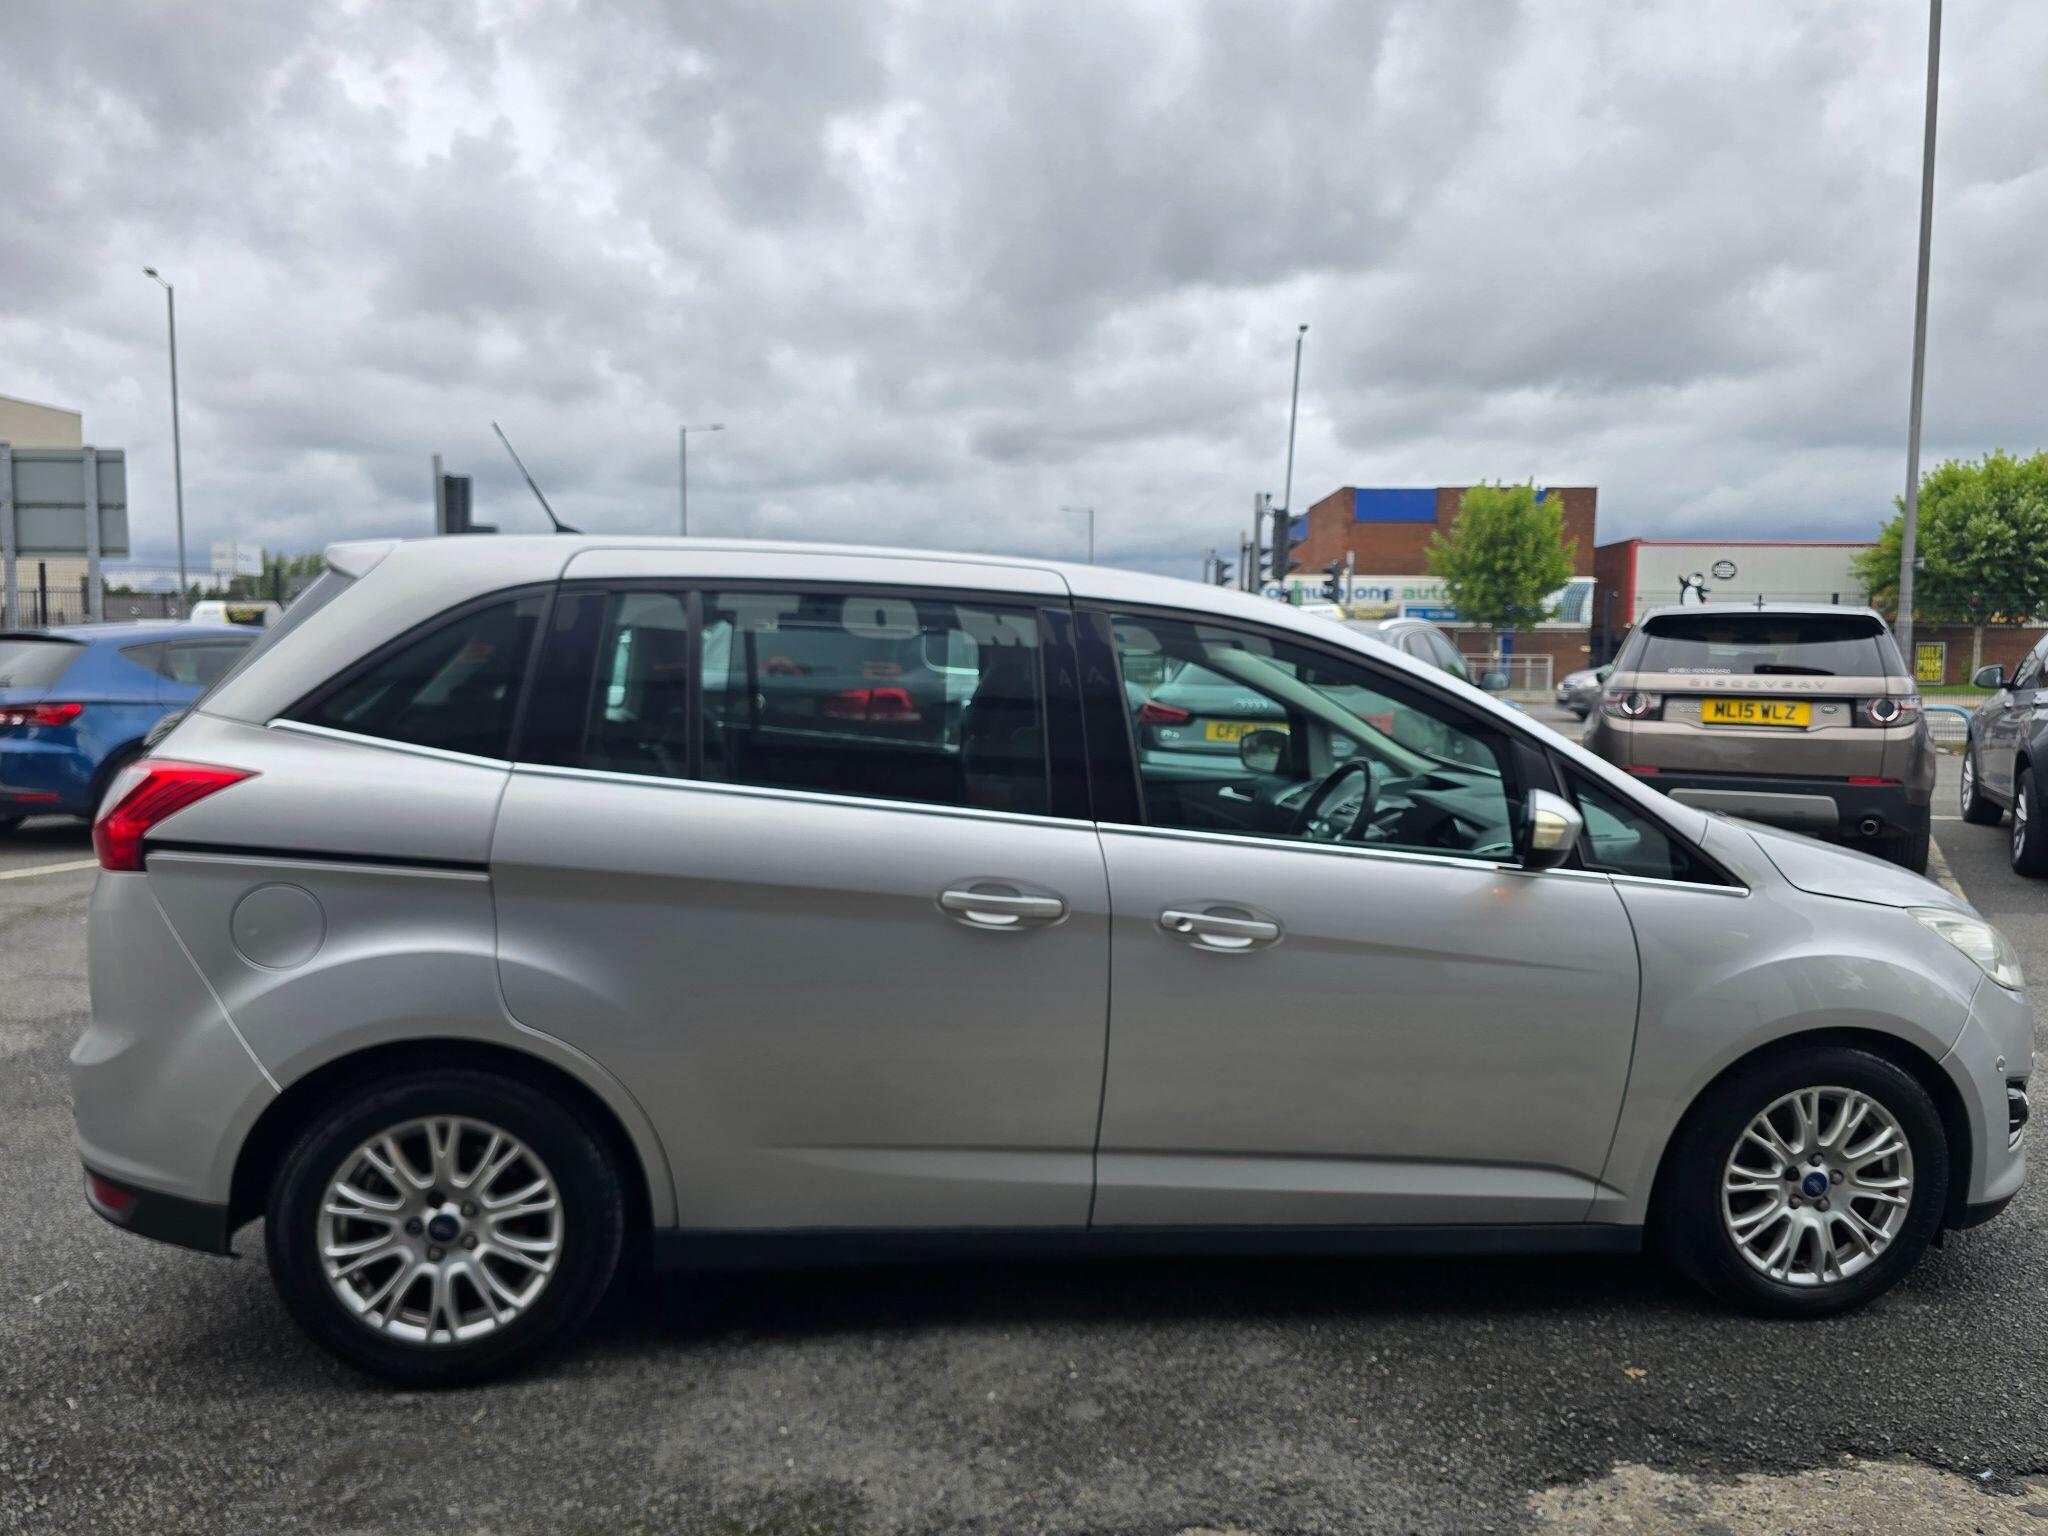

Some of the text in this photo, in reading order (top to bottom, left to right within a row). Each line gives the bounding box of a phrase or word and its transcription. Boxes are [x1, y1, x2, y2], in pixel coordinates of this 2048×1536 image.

[1689, 678, 1826, 690] DISCOVERY
[1714, 702, 1755, 719] ML15
[1761, 704, 1797, 721] WLZ
